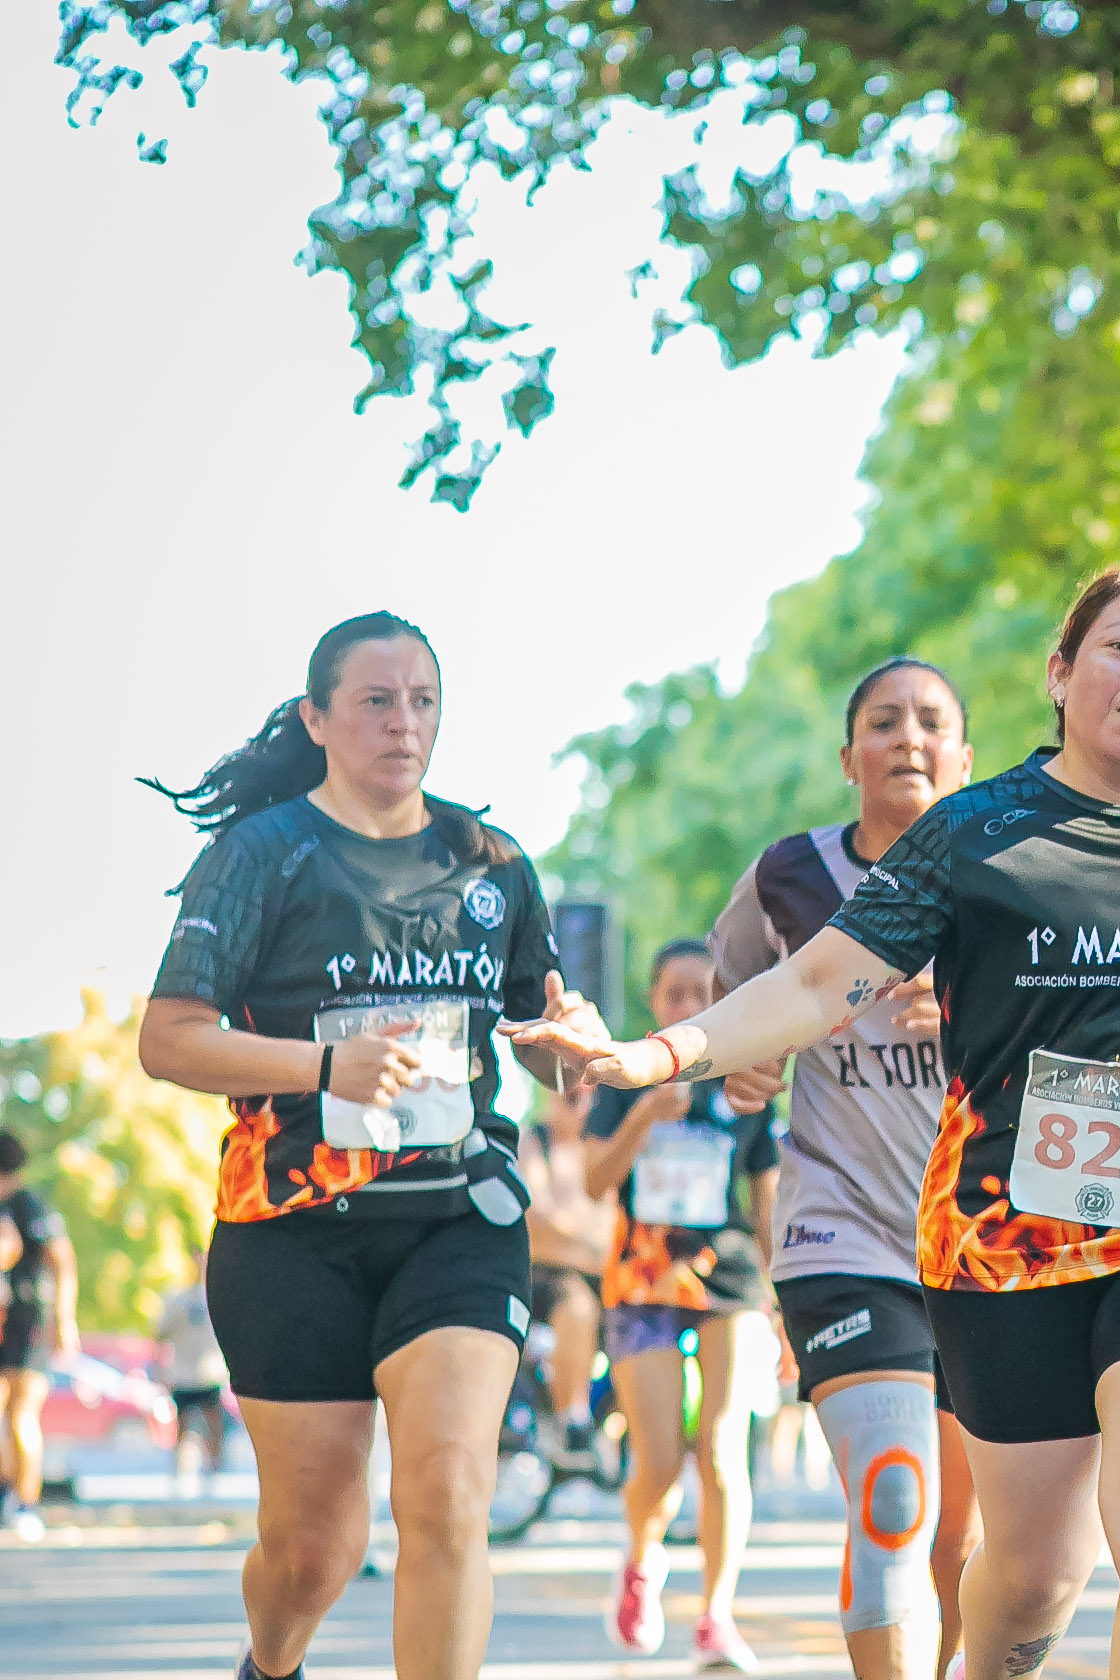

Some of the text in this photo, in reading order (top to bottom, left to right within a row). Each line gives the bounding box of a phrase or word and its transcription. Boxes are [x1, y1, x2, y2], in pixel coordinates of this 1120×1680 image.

[1026, 925, 1057, 966] 1°
[1015, 973, 1077, 988] ASOCIACIÓN
[1086, 1193, 1104, 1208] 27
